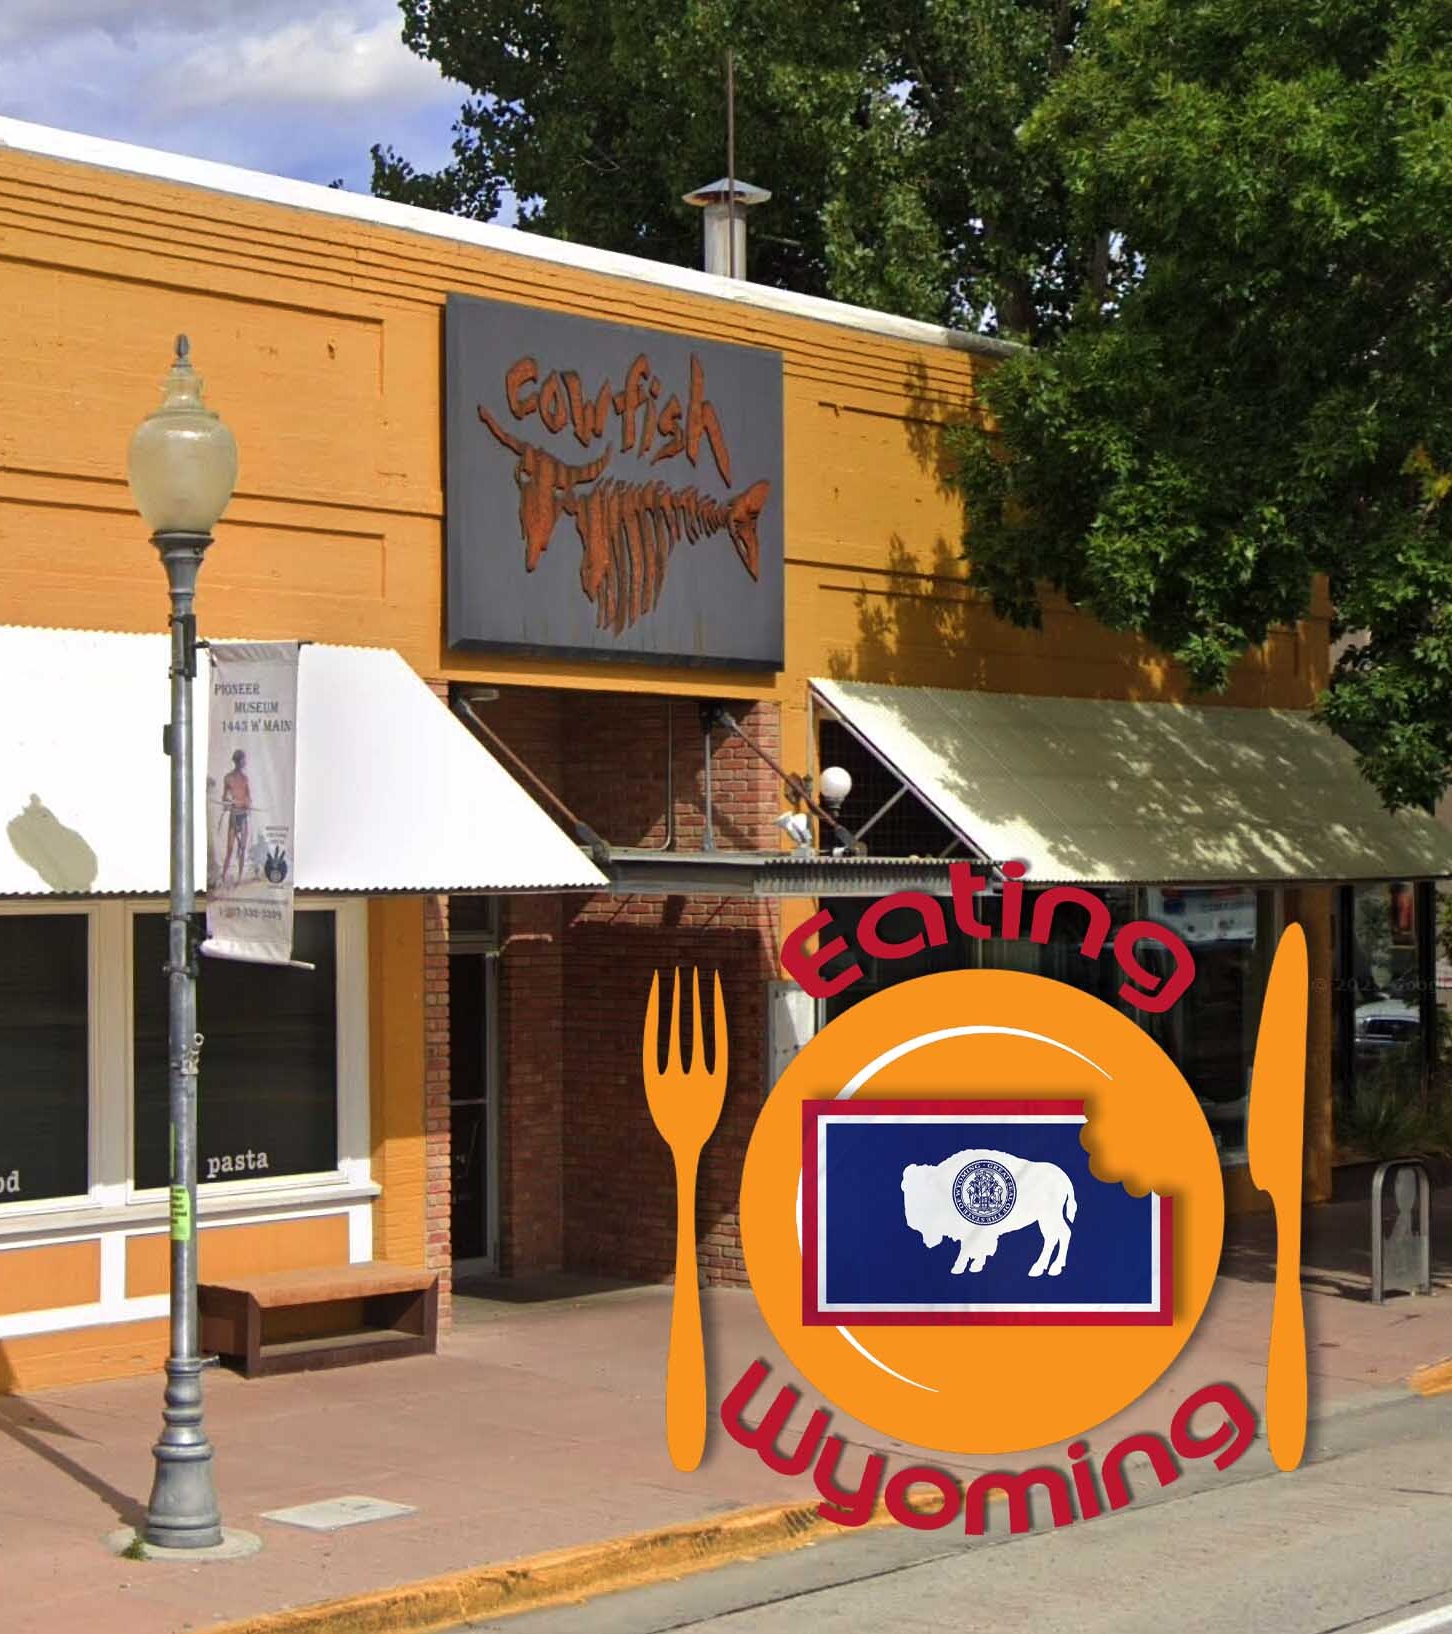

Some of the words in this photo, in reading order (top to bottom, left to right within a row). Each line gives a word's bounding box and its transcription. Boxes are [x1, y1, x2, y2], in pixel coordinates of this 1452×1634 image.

[214, 683, 260, 695] PIONEER
[234, 701, 279, 713] MUSEUM
[263, 719, 292, 732] MAIN
[206, 1149, 269, 1179] pasta
